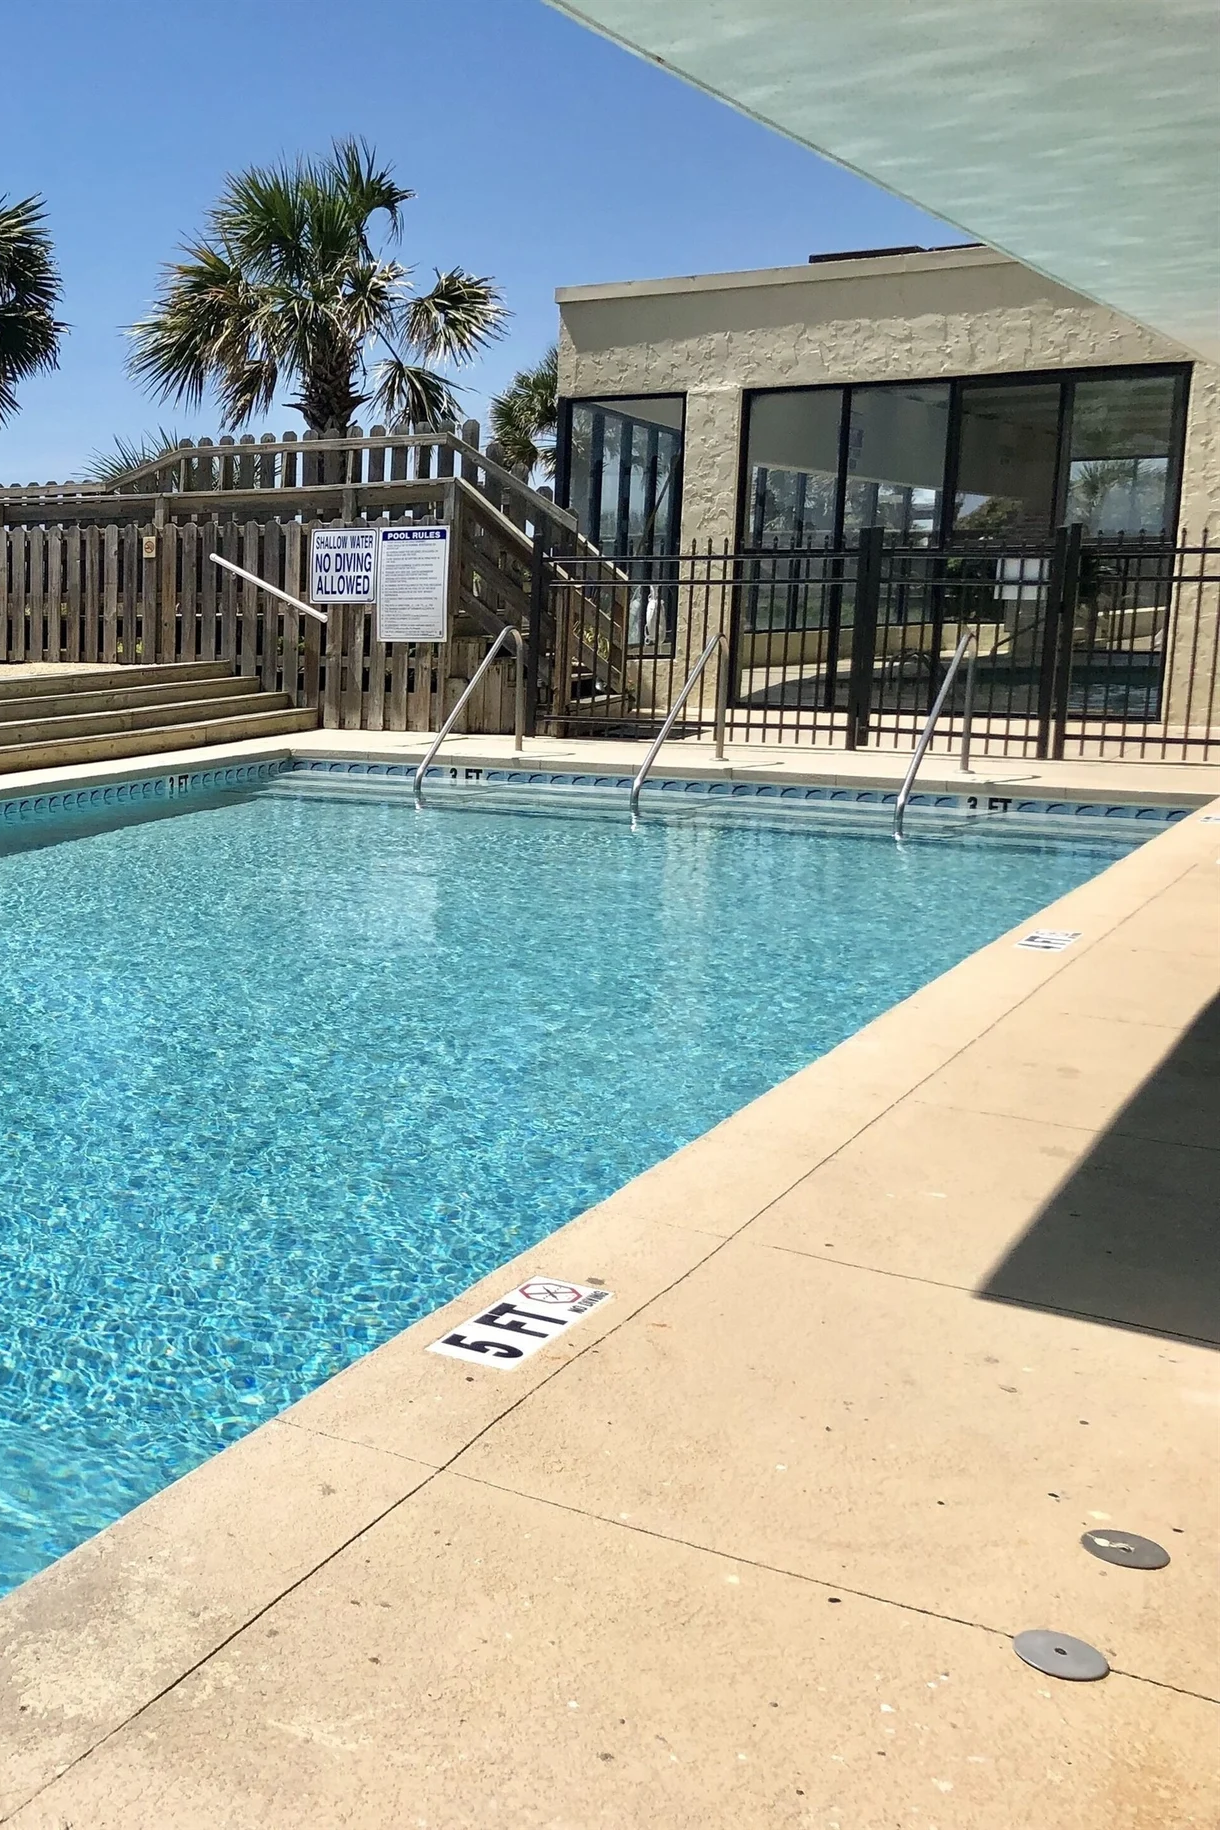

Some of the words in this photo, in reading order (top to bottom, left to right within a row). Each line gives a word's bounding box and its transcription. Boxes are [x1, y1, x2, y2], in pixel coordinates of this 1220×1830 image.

[315, 536, 348, 550] SHALLOW
[350, 535, 373, 549] WATER
[387, 532, 410, 540] POOL
[412, 531, 441, 539] RULES
[315, 553, 331, 573] NO
[335, 552, 372, 573] DIVING
[316, 575, 370, 595] ALLOWED
[473, 1302, 568, 1339] FT
[441, 1333, 524, 1359] 5
